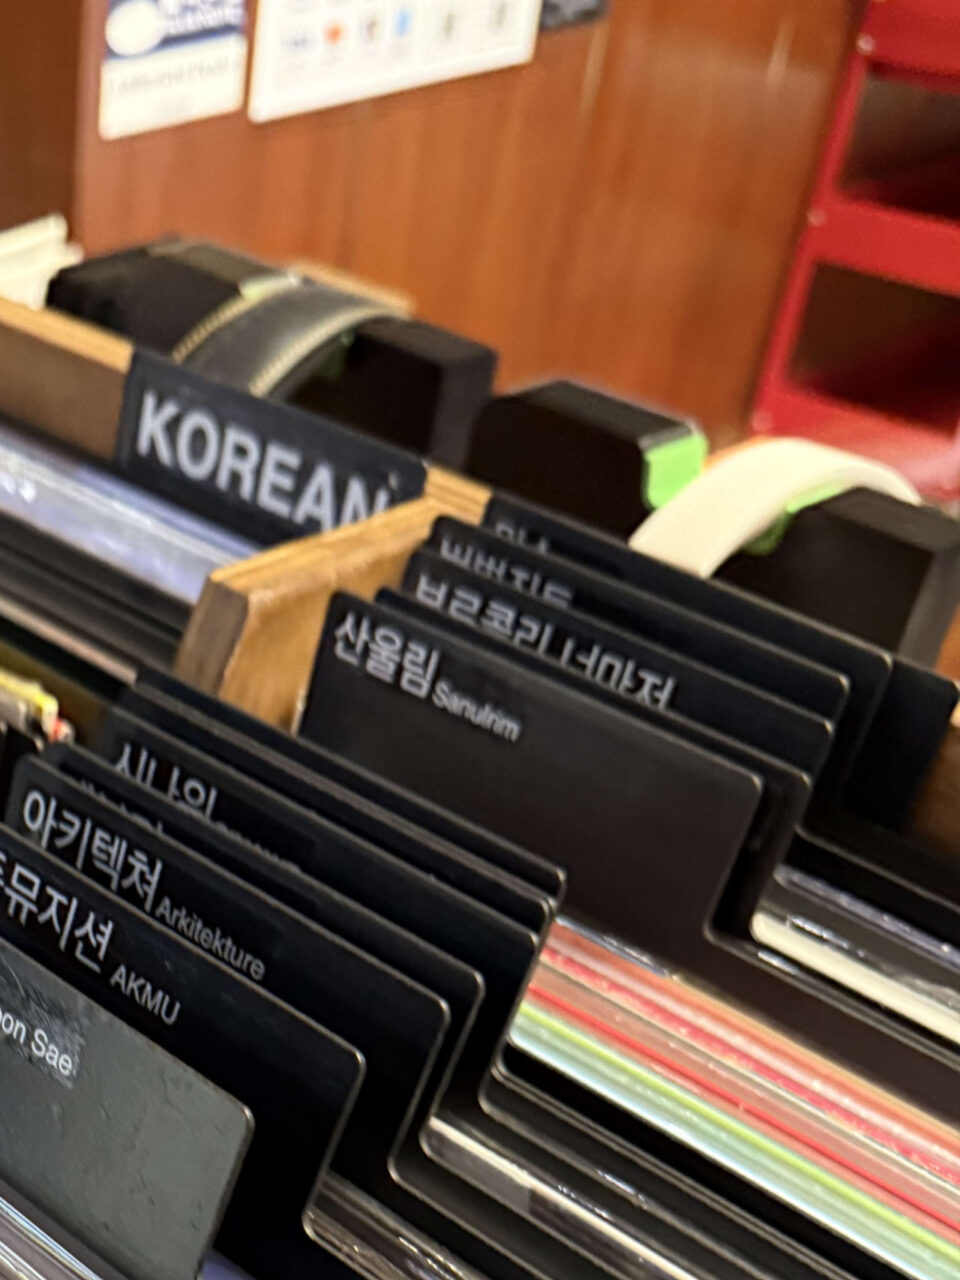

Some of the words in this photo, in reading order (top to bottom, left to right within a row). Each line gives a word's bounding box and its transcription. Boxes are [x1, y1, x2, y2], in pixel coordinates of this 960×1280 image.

[135, 391, 390, 533] KOREAN
[334, 610, 440, 700] 산울림
[154, 896, 267, 983] Arkitekture
[109, 963, 183, 1027] AKMU
[30, 1028, 74, 1077] Sae
